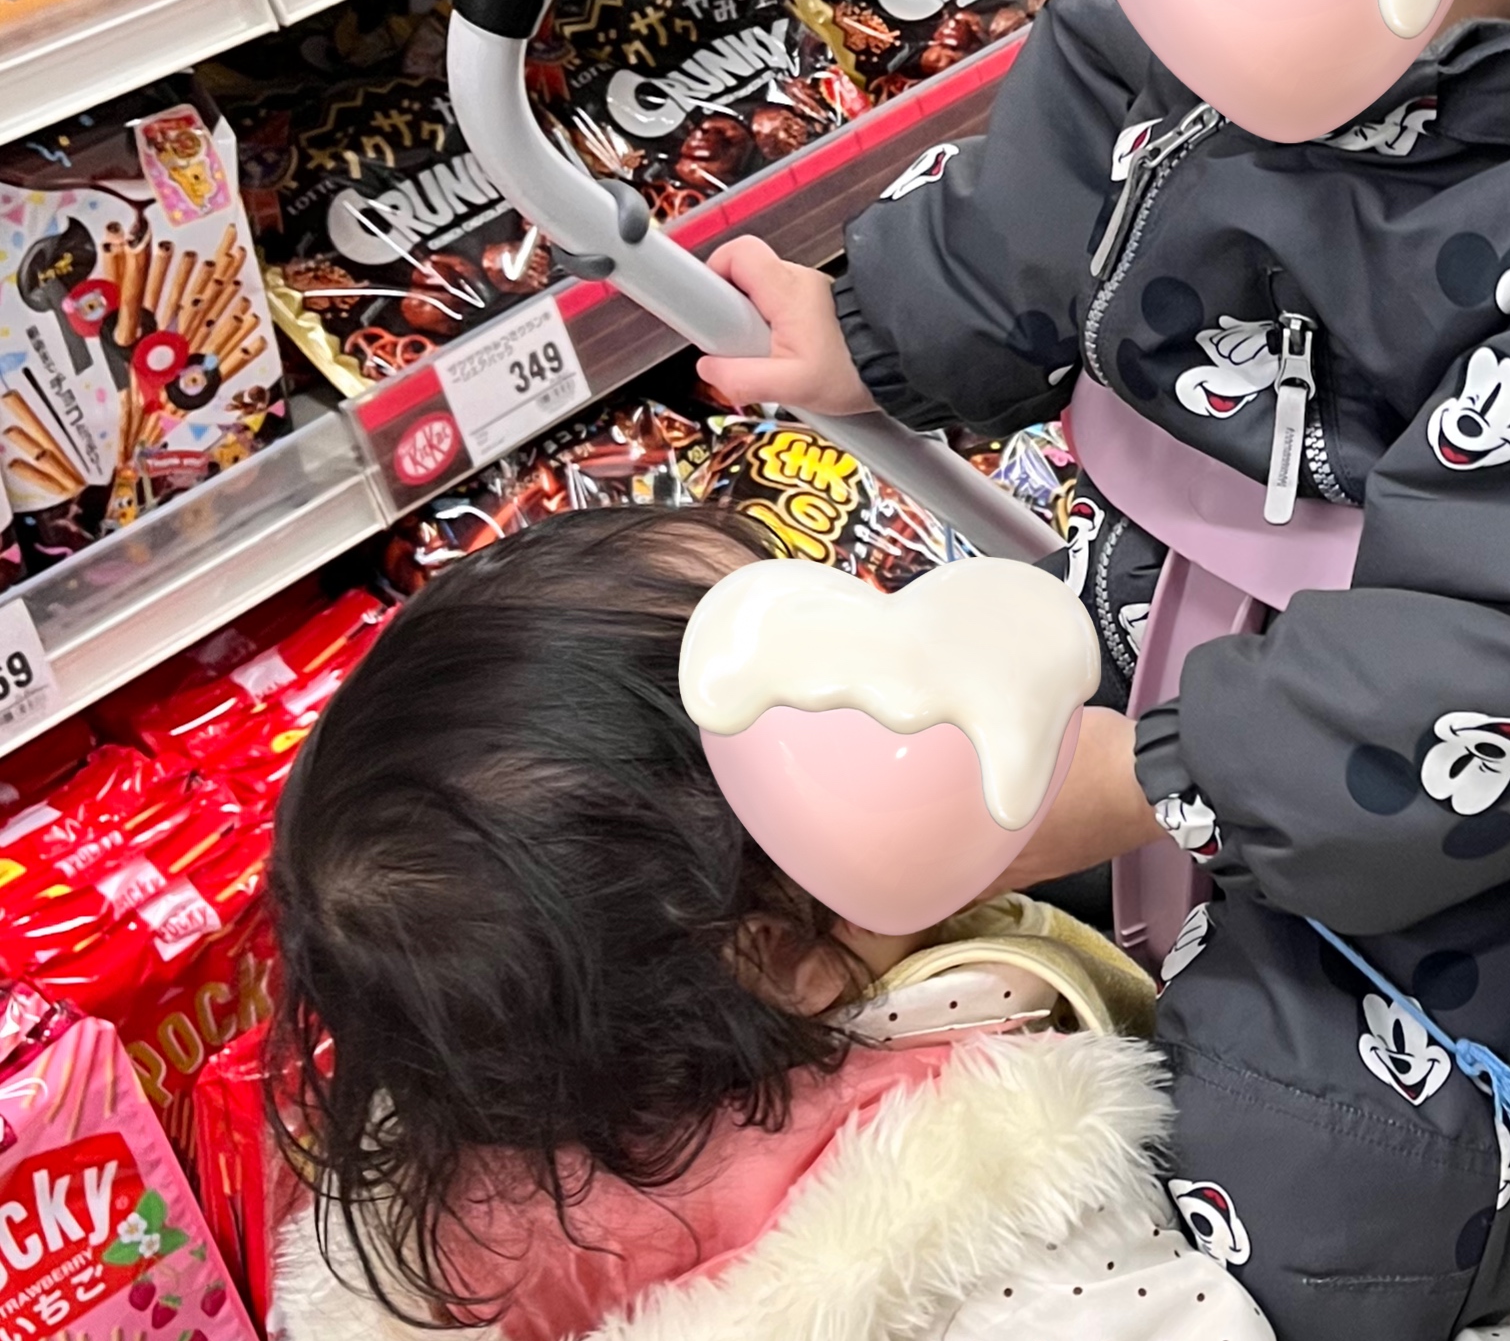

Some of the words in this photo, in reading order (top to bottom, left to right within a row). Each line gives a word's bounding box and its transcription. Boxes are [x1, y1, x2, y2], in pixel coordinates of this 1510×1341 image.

[606, 18, 796, 139] CRUNKY
[509, 341, 564, 394] 349
[0, 1160, 118, 1292] cky
[0, 1246, 94, 1320] TRAWBERRY
